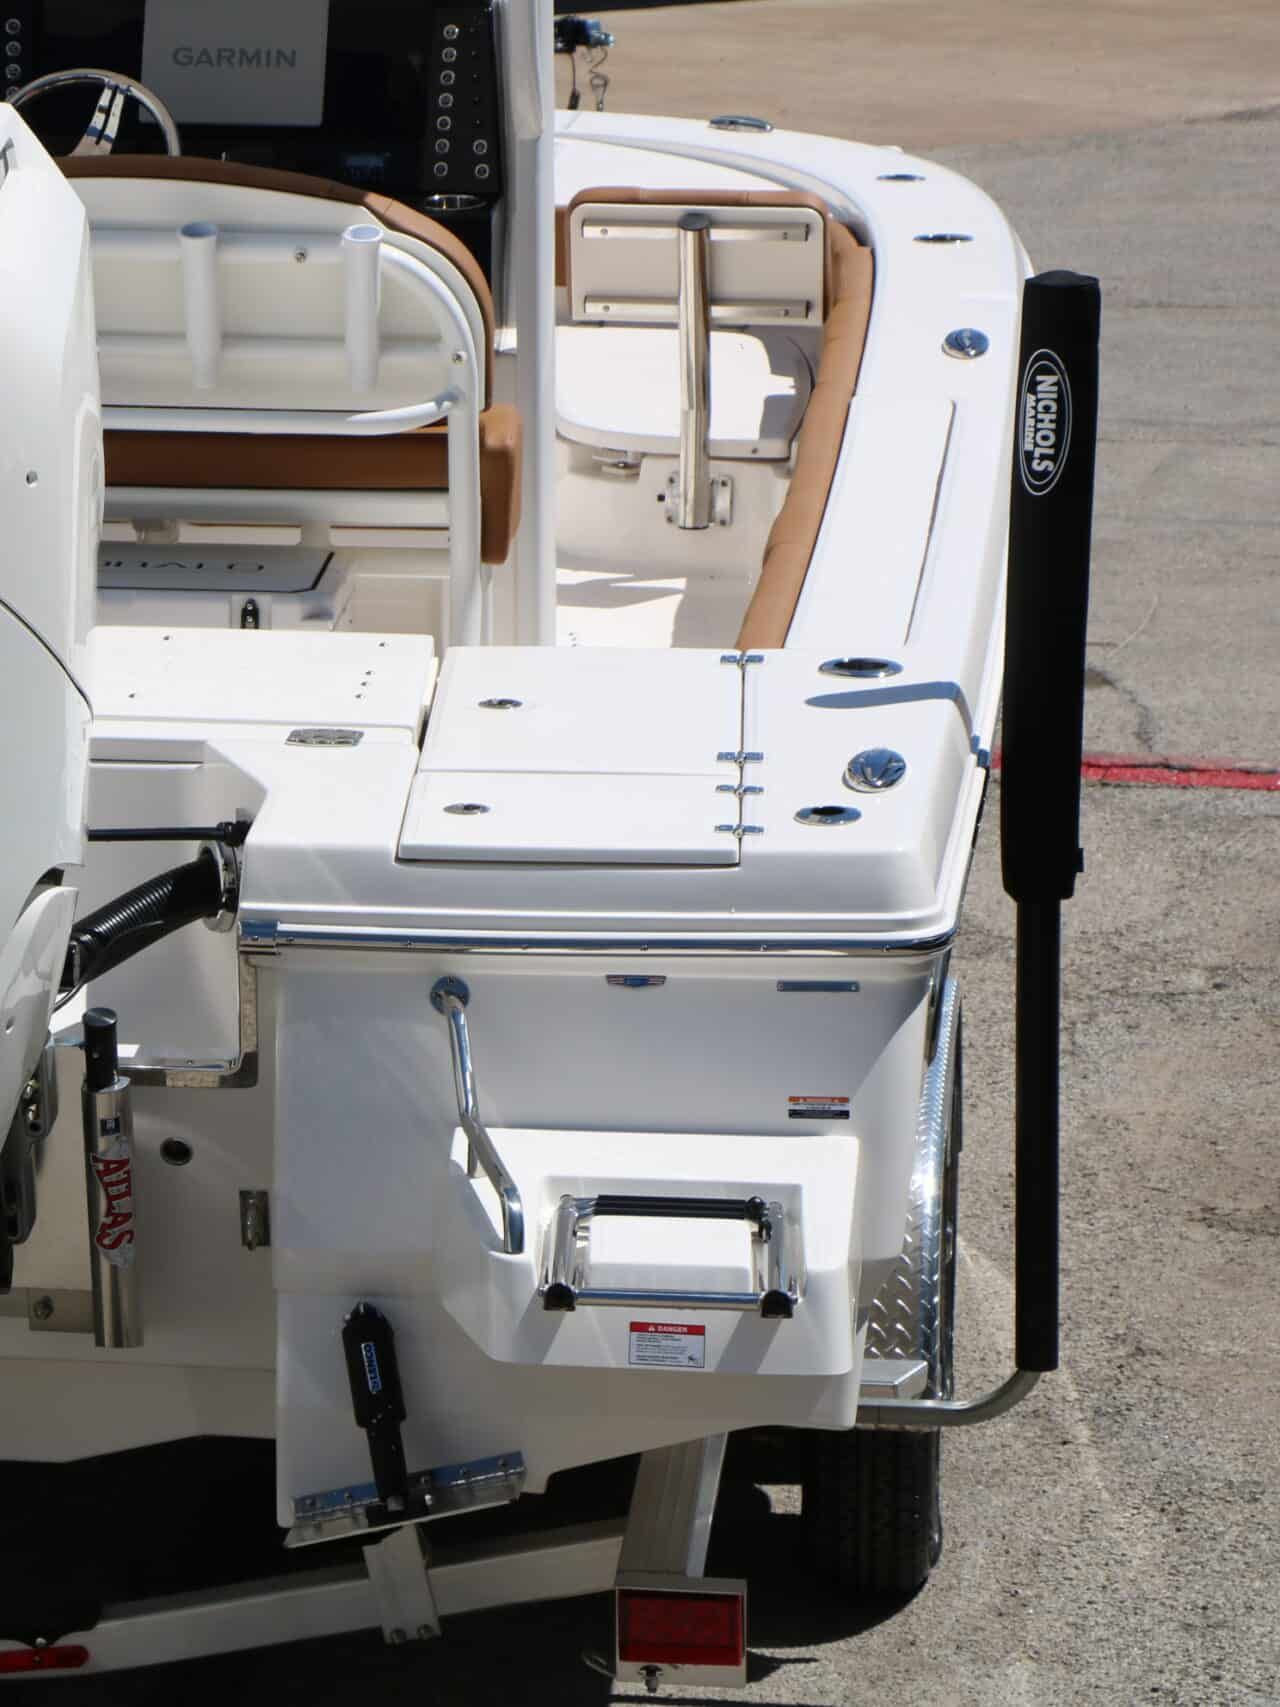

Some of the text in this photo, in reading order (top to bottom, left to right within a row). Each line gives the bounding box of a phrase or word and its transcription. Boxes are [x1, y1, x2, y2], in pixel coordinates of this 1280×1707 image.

[173, 47, 297, 68] GARMIN
[1031, 374, 1060, 473] NICHOLS
[91, 1151, 136, 1250] ATLAS
